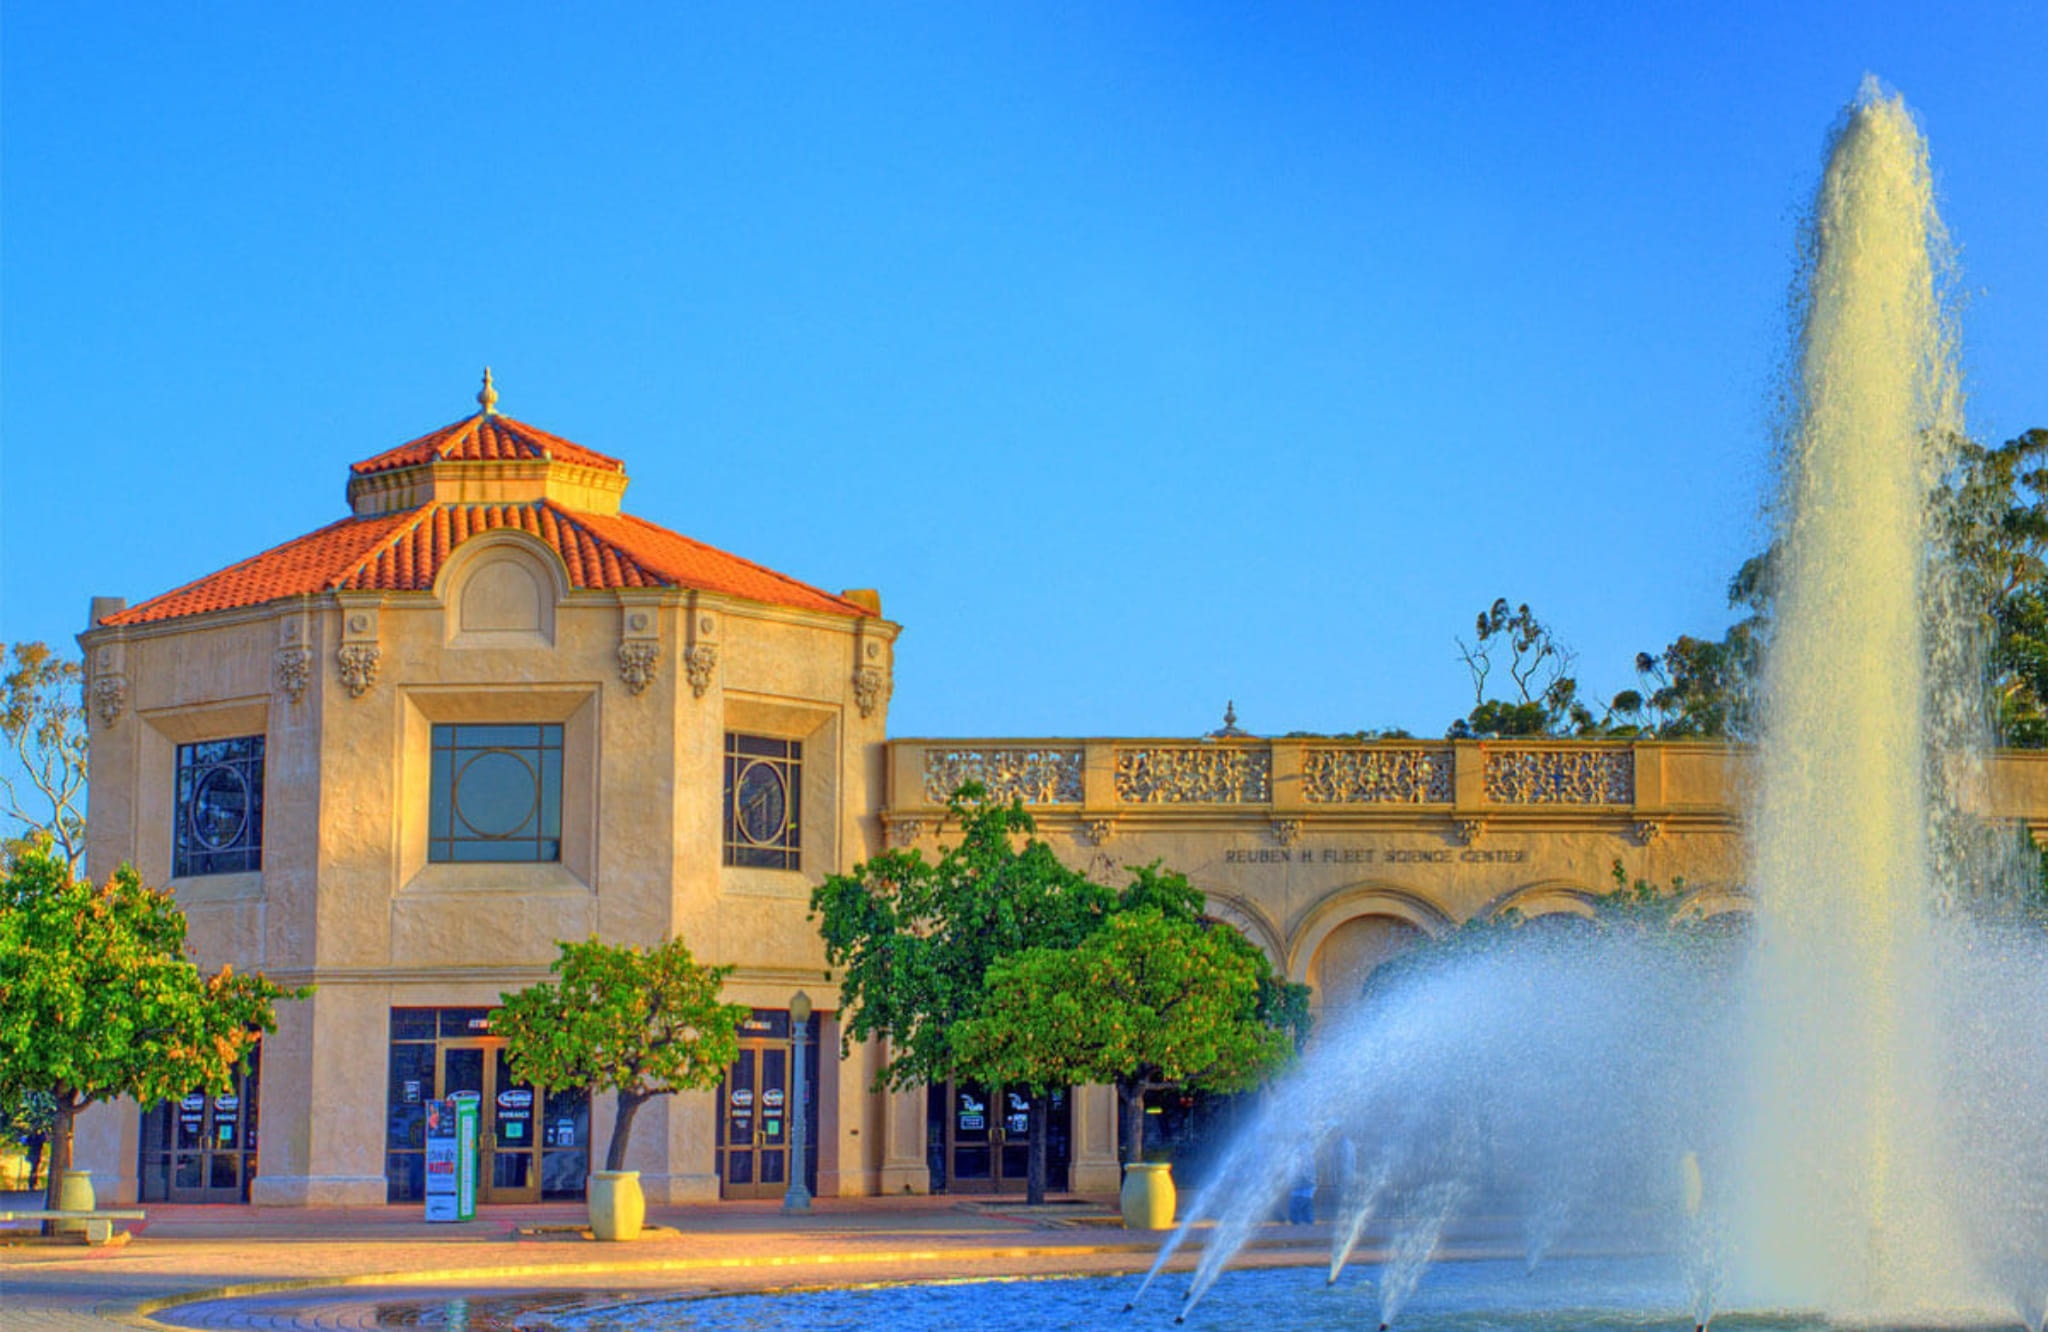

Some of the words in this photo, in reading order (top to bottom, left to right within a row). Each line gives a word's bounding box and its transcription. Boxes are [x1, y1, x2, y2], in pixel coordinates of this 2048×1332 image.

[1225, 849, 1291, 863] REUBEN
[1322, 849, 1376, 863] FLEET
[1383, 849, 1453, 863] SCIENCE
[1460, 849, 1525, 863] CENTER
